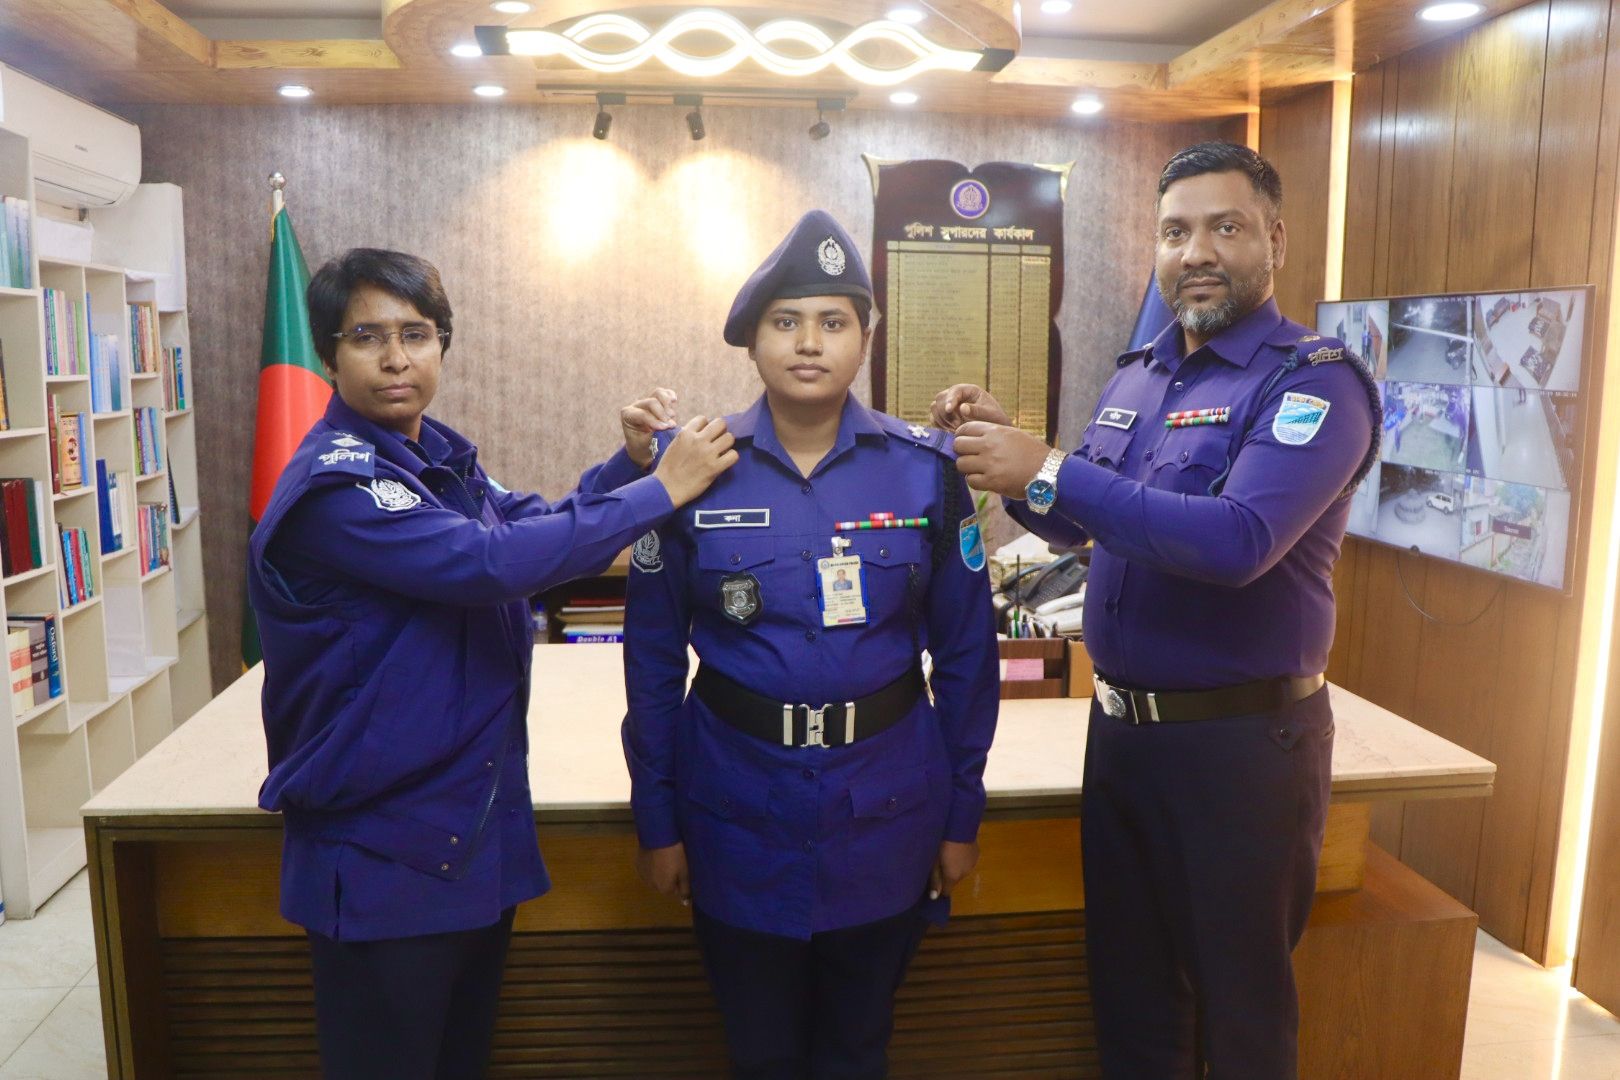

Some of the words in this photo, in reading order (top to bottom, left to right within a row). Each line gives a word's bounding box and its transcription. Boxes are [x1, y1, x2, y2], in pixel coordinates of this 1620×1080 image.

[904, 222, 934, 239] পুলিশ
[1308, 347, 1344, 366] পুলিশ
[319, 448, 372, 465] পুলিশ
[50, 626, 58, 662] Oxford
